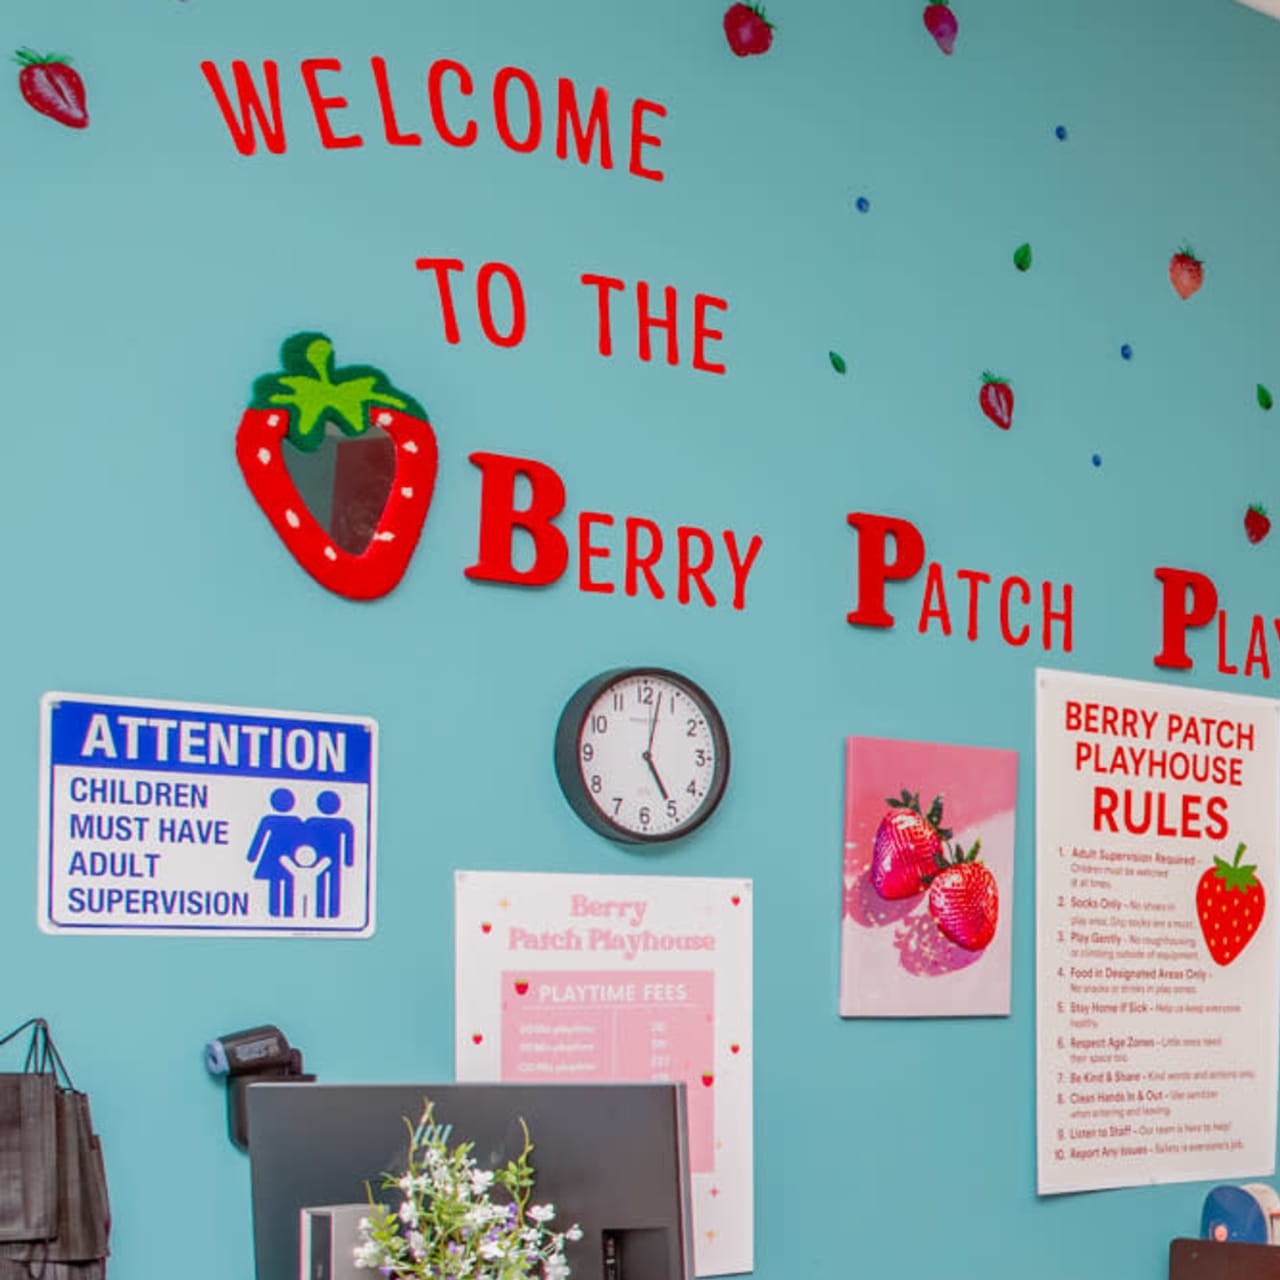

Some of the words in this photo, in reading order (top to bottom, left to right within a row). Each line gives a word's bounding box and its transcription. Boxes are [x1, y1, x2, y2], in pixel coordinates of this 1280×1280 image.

[201, 56, 668, 182] WELCOME
[415, 257, 527, 348] TO
[580, 273, 729, 375] THE
[464, 451, 763, 611] BERRY
[846, 511, 1073, 653] PATCH
[613, 693, 624, 712] 11
[637, 686, 654, 705] 12
[591, 715, 607, 734] 10
[686, 719, 697, 736] 2
[1065, 701, 1158, 740] BERRY
[1168, 714, 1254, 752] PATCH
[81, 714, 347, 772] ATTENTION
[583, 744, 594, 761] 9
[695, 749, 706, 767] 3
[1076, 741, 1243, 786] PLAYHOUSE
[69, 776, 209, 808] CHILDREN
[591, 775, 602, 793] 8
[686, 780, 696, 797] 4
[612, 798, 622, 815] 7
[639, 807, 650, 825] 6
[667, 800, 677, 817] 5
[1093, 786, 1229, 840] RULES
[69, 814, 149, 842] MUST
[159, 819, 230, 845] HAVE
[68, 851, 161, 878] ADULT
[67, 888, 249, 916] SUPERVISION
[569, 893, 647, 928] Berry
[508, 926, 584, 952] Patch
[587, 927, 717, 962] Playhouse
[1070, 966, 1093, 978] Food
[539, 984, 637, 1003] PLAYTIME
[643, 983, 688, 1002] FEES
